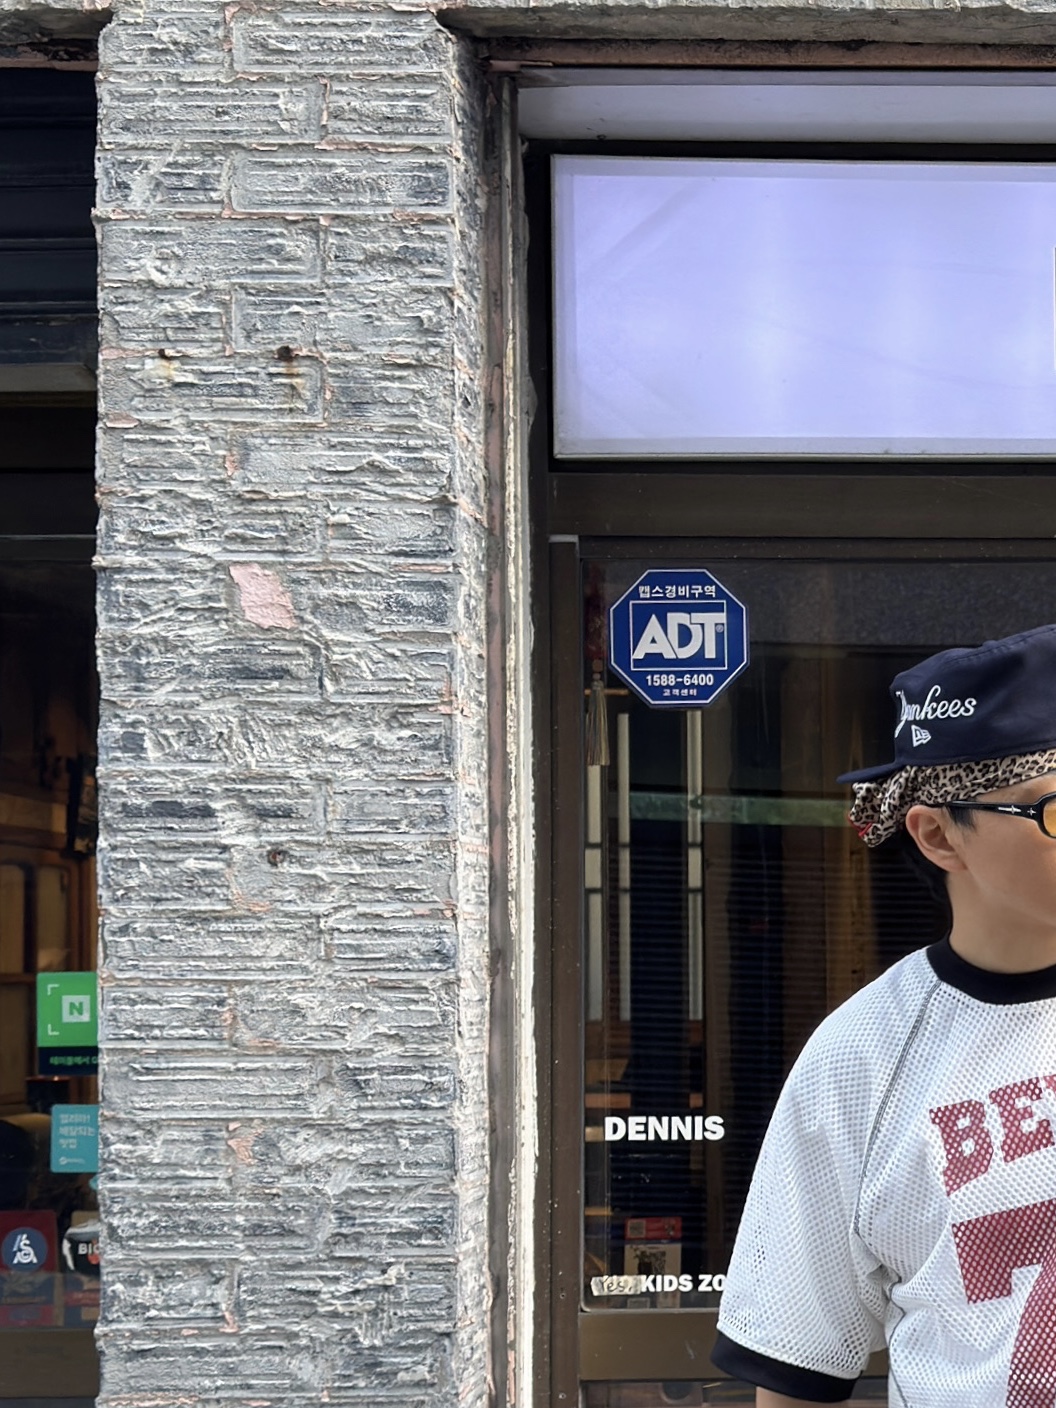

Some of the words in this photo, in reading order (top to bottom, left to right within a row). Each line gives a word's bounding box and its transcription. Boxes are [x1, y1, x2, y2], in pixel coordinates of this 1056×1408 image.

[638, 584, 717, 599] 캡스경비구역
[632, 611, 726, 660] ADT
[645, 673, 715, 688] 1588-6400
[894, 684, 978, 738] Yankees
[604, 1115, 726, 1142] DENNIS
[641, 1274, 694, 1293] KIDS
